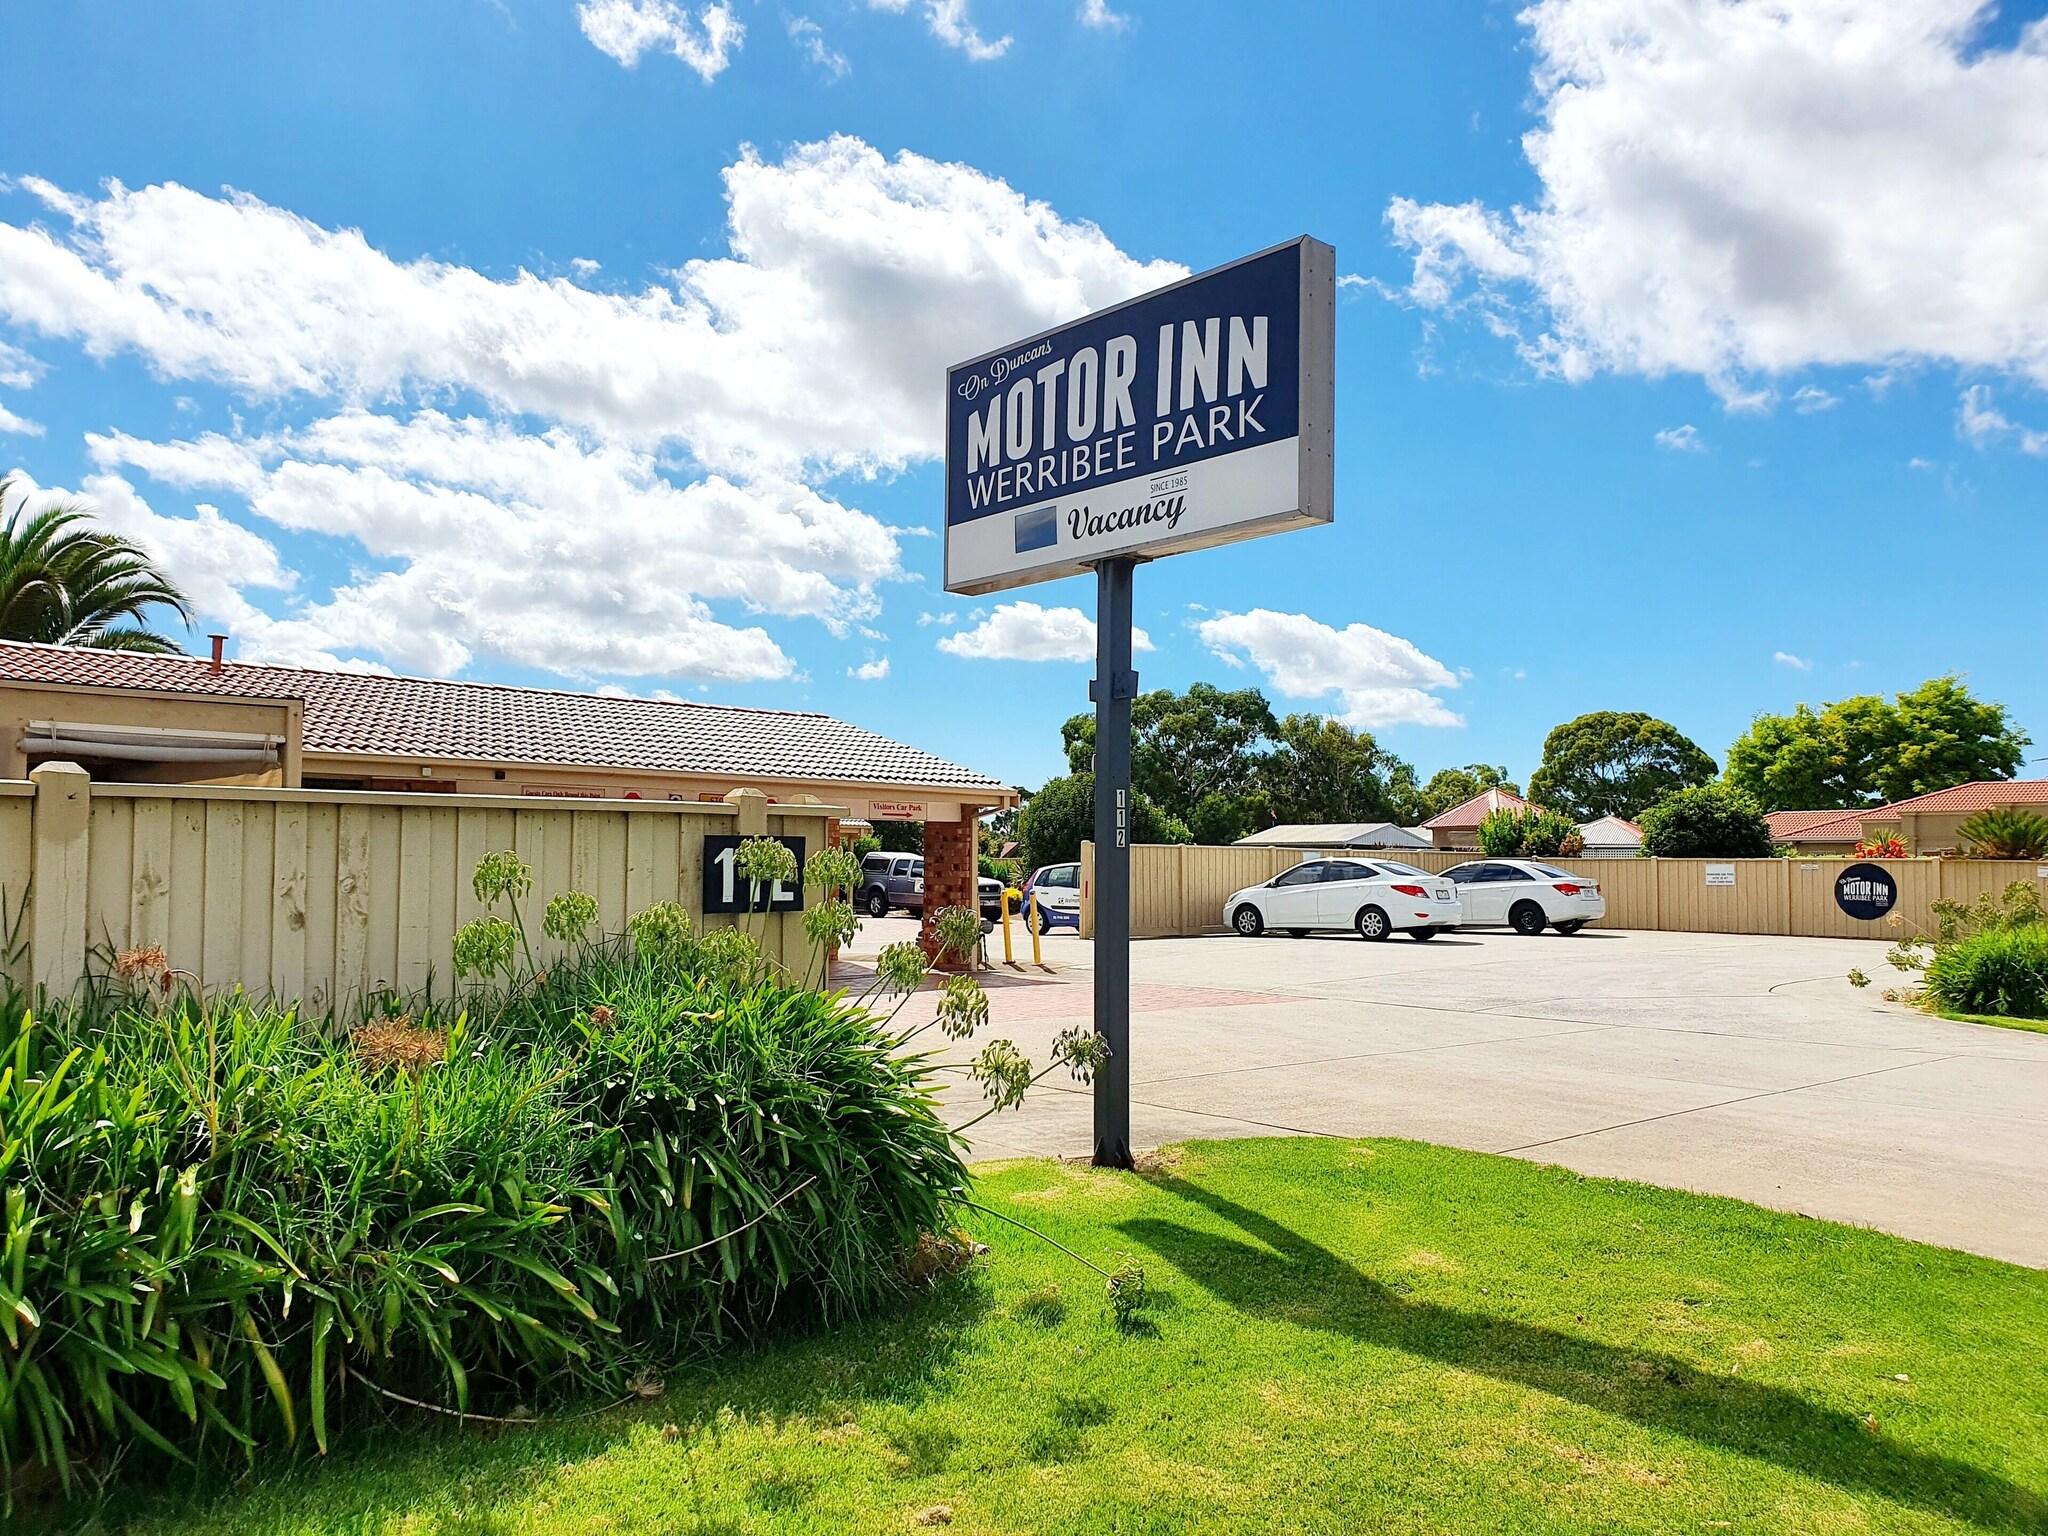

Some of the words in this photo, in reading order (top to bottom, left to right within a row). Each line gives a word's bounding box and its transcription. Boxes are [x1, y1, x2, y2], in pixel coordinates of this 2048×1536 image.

[958, 375, 989, 400] On
[990, 340, 1053, 386] Duncans
[967, 334, 1137, 475] MOTOR
[1156, 316, 1269, 418] INN
[967, 431, 1136, 510] WERRIBEE
[1153, 394, 1266, 461] PARK
[1150, 480, 1169, 493] SINCE
[1171, 476, 1188, 489] 1985
[1067, 495, 1187, 540] Vacancy
[872, 802, 895, 811] Visitors
[908, 804, 922, 812] Park
[1843, 880, 1871, 895] MOTOR
[1873, 882, 1888, 896] INN
